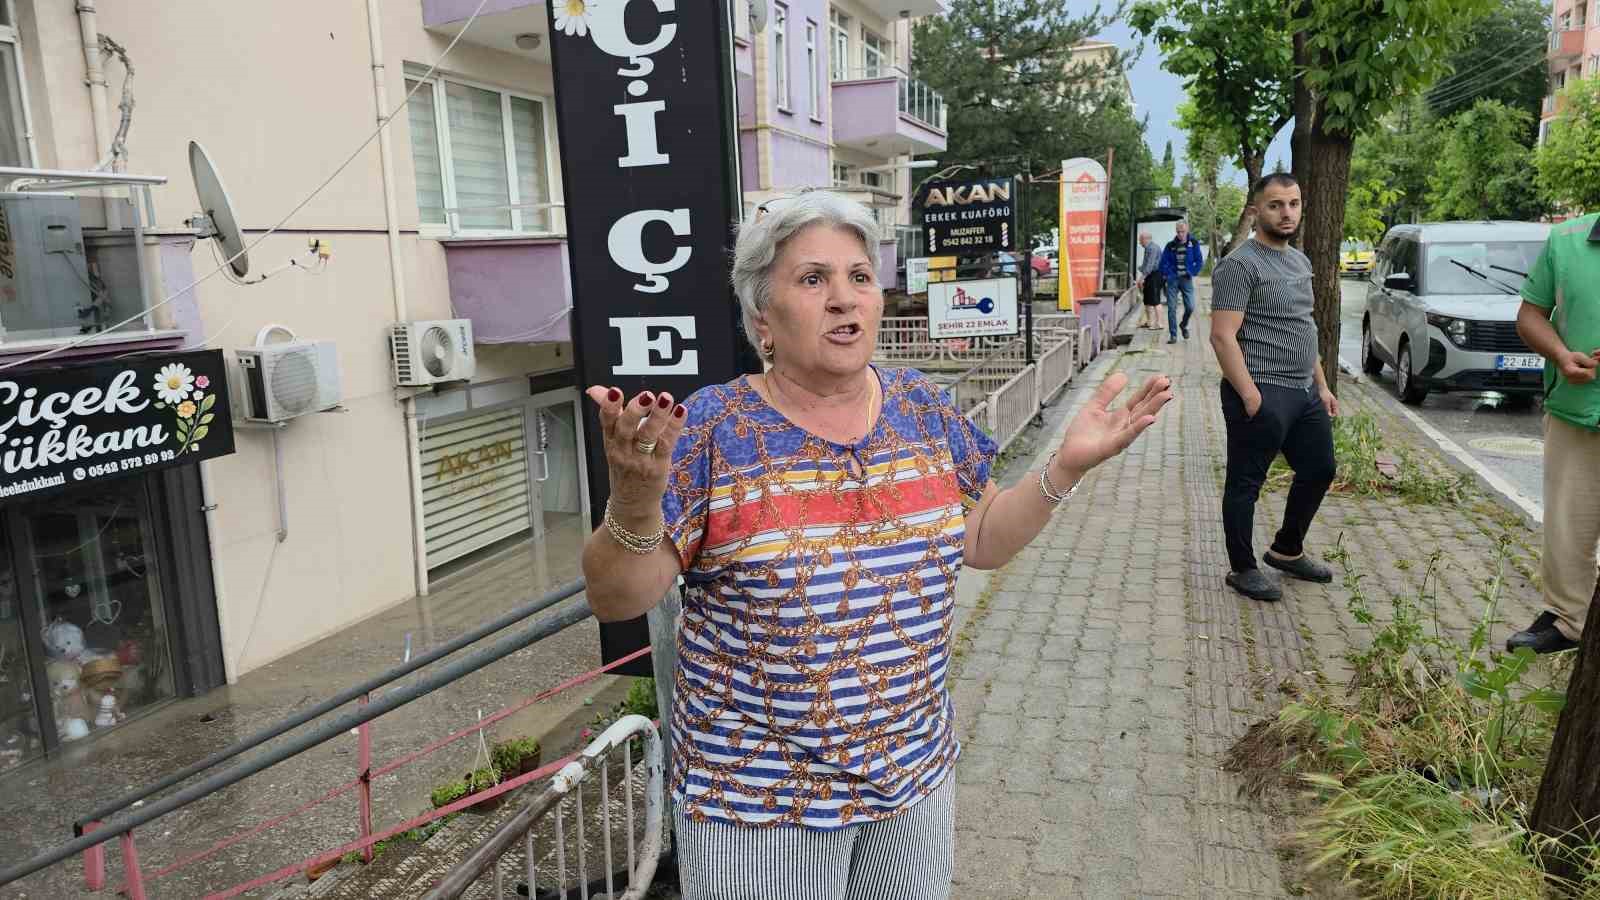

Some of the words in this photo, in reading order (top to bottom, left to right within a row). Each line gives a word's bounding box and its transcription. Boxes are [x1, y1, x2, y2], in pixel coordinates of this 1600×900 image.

[924, 182, 1010, 207] AKAN
[925, 212, 957, 222] ERKEK
[961, 206, 1010, 219] KUAFÖRÜ
[950, 226, 985, 236] MUZAFFER
[977, 319, 1009, 328] EMLAK
[1503, 356, 1516, 367] 22
[0, 424, 169, 473] ükkanı
[88, 461, 119, 477] 0542
[121, 456, 143, 470] 572
[160, 449, 175, 461] 92
[436, 438, 514, 481] AKAN
